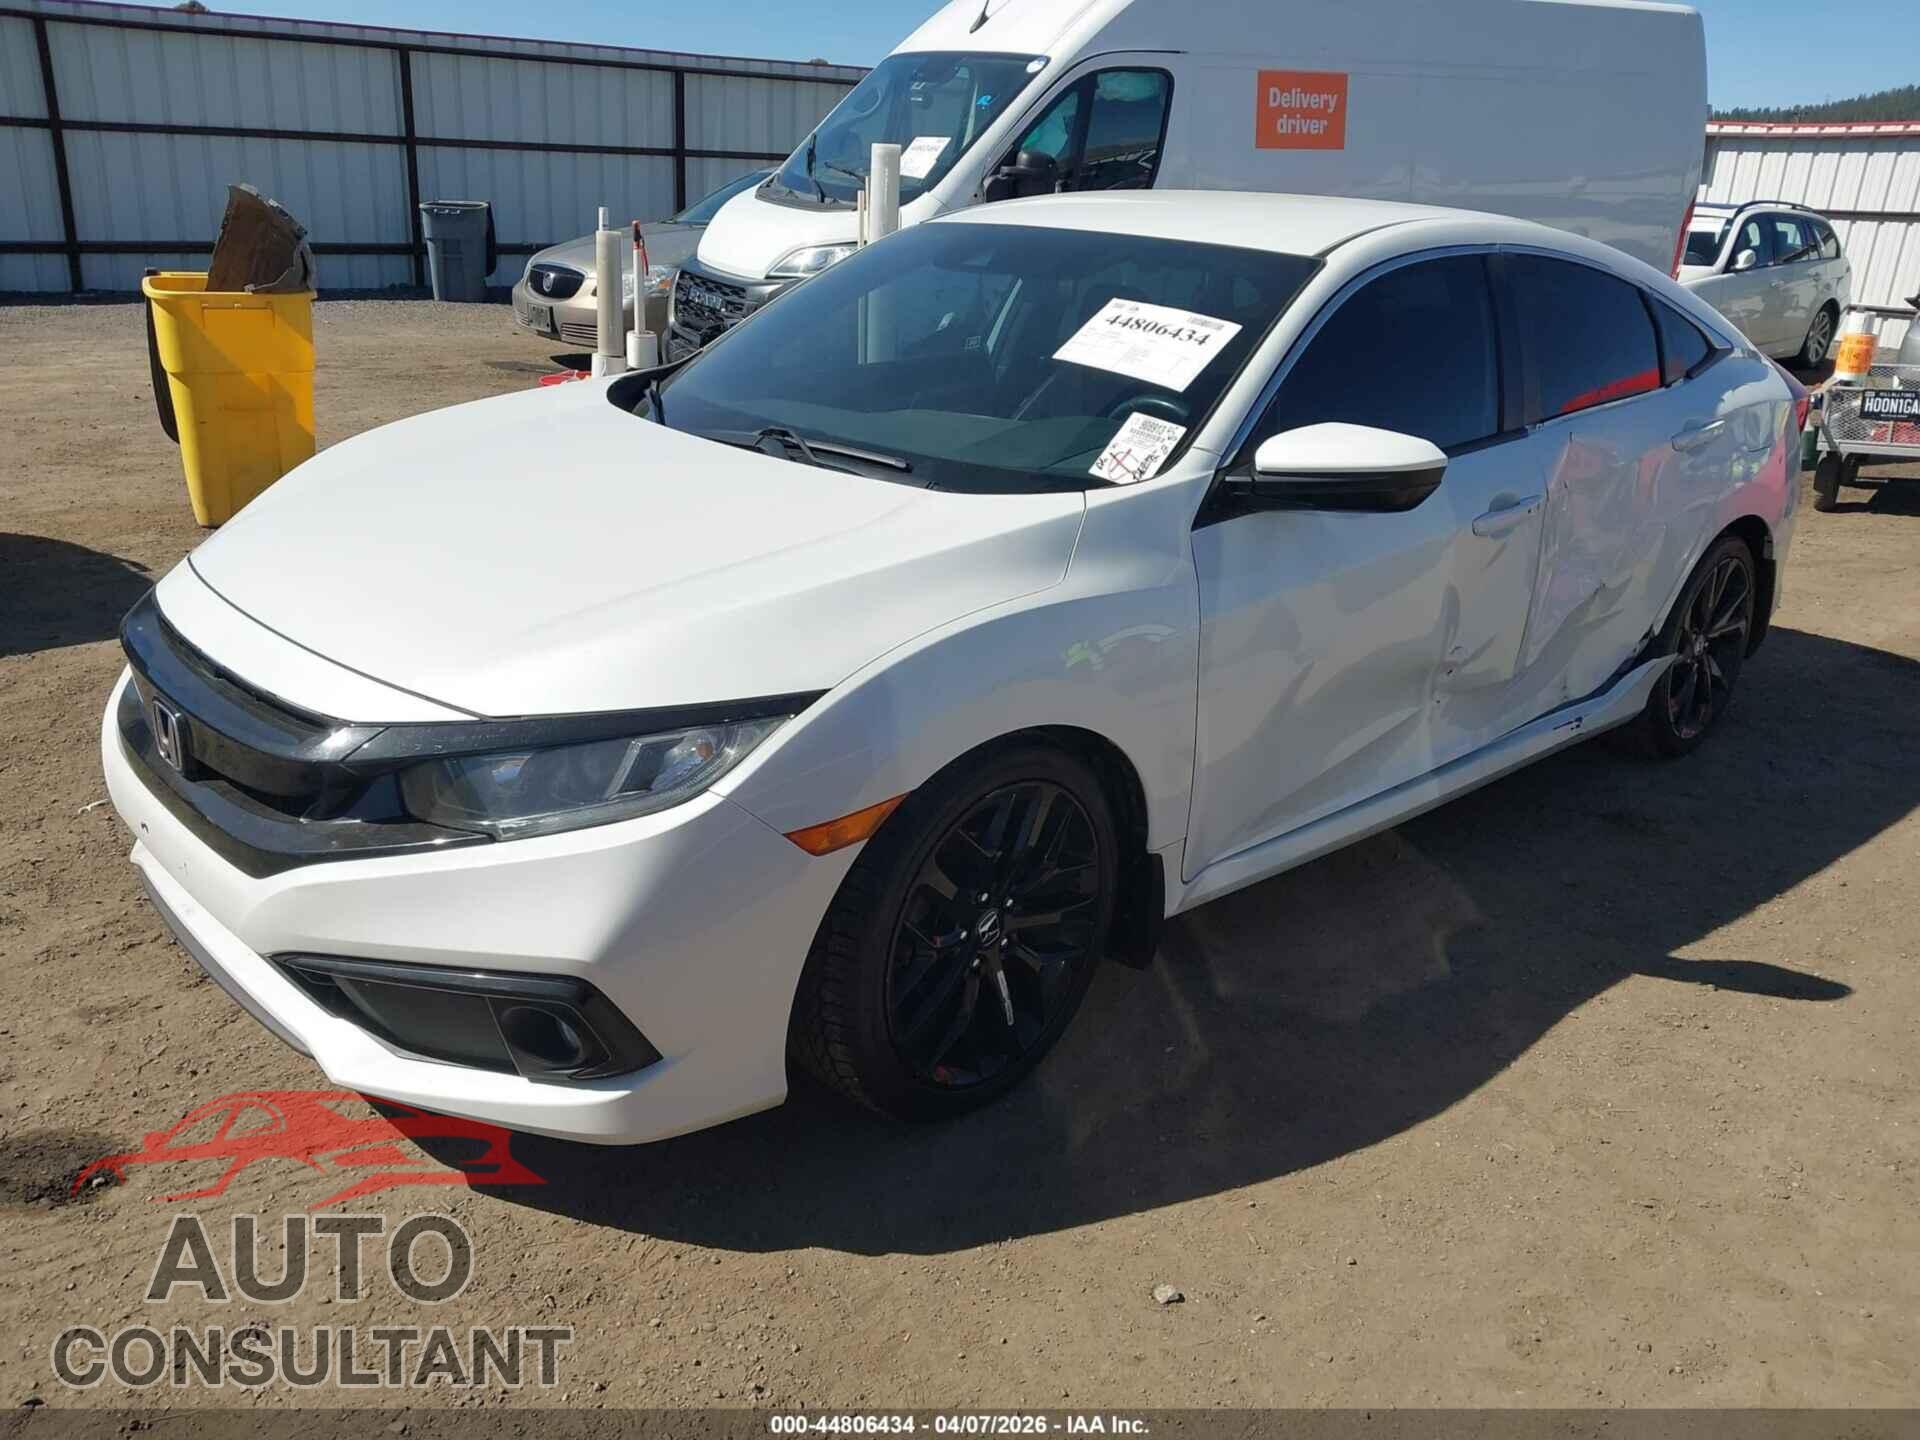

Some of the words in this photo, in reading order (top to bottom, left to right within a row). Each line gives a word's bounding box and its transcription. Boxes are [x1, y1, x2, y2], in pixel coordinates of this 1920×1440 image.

[1269, 87, 1337, 113] Delivery
[1277, 114, 1328, 134] driver
[1105, 314, 1211, 346] 44806434
